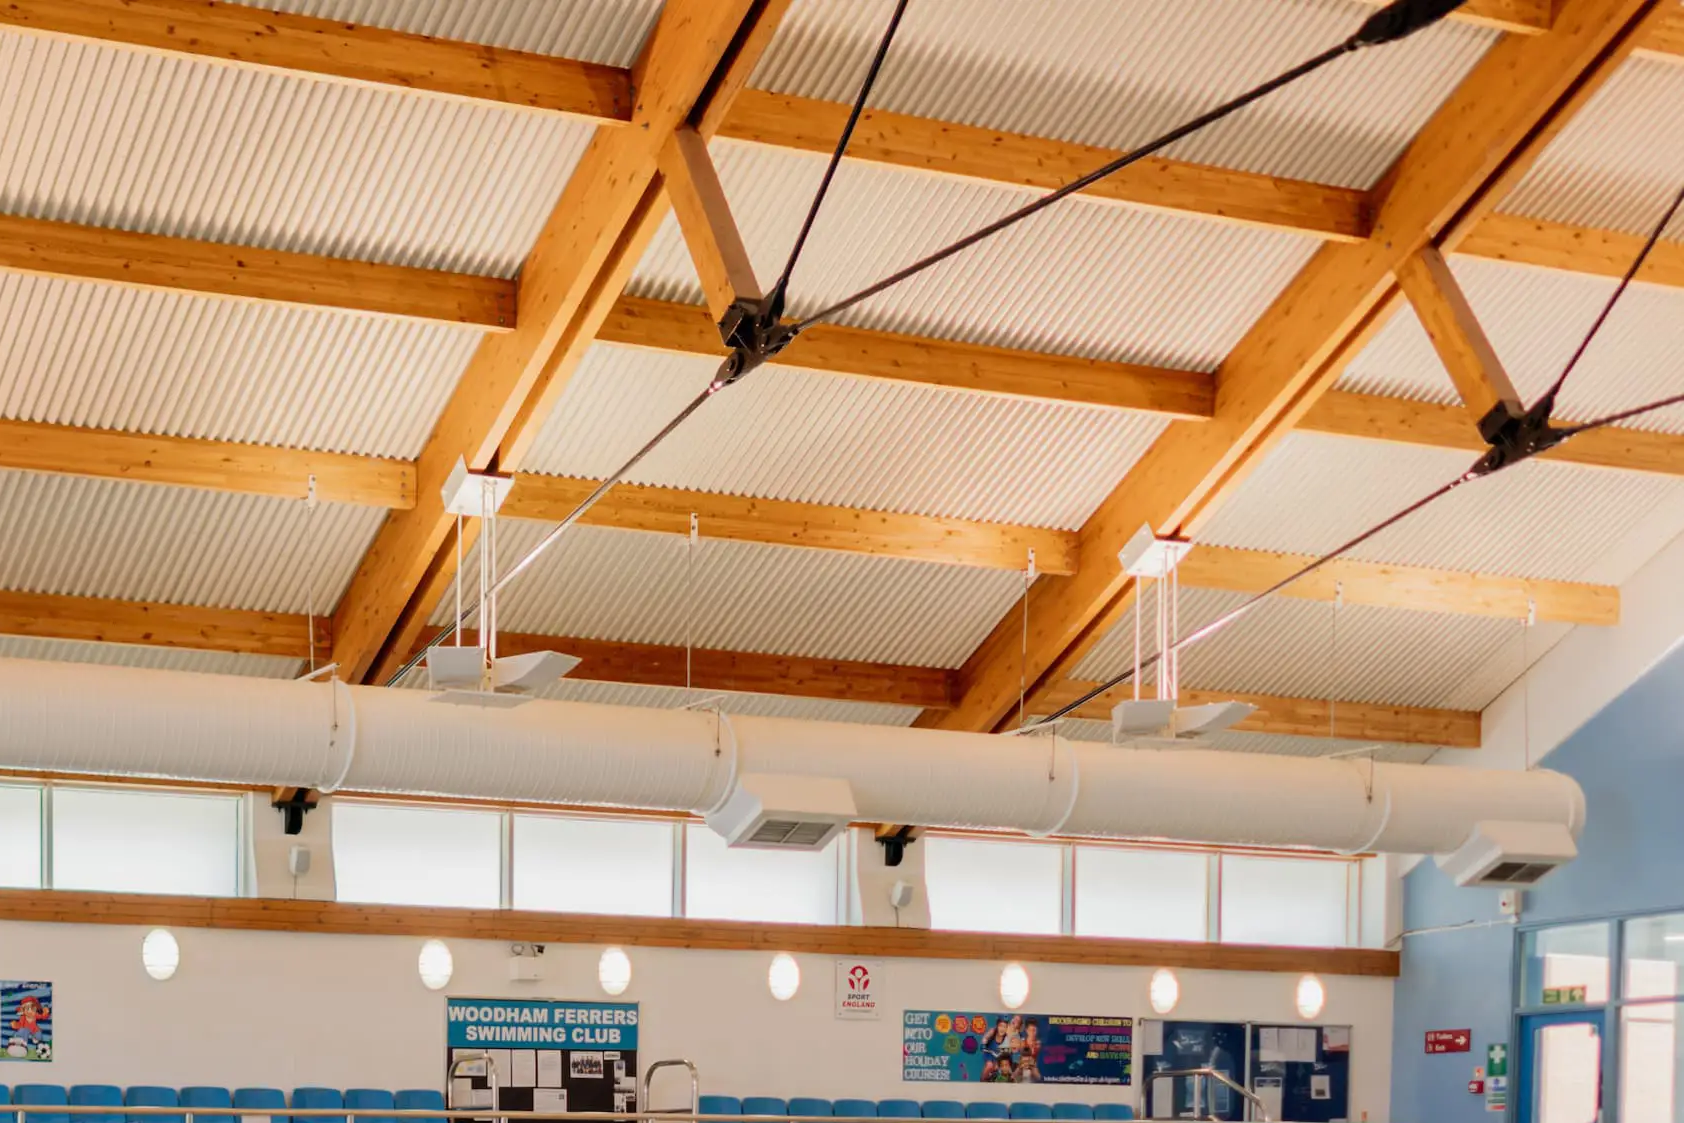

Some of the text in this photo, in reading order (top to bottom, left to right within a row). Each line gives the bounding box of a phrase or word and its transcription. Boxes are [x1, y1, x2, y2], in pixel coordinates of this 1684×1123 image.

[847, 993, 870, 1001] SPORT
[842, 1000, 876, 1008] ENGLAND
[448, 1006, 638, 1025] WOODHAM FERRERS
[905, 1012, 930, 1025] GET
[466, 1025, 622, 1043] SWIMMING CLUB
[904, 1027, 933, 1040] INTO
[905, 1041, 927, 1053] OUR
